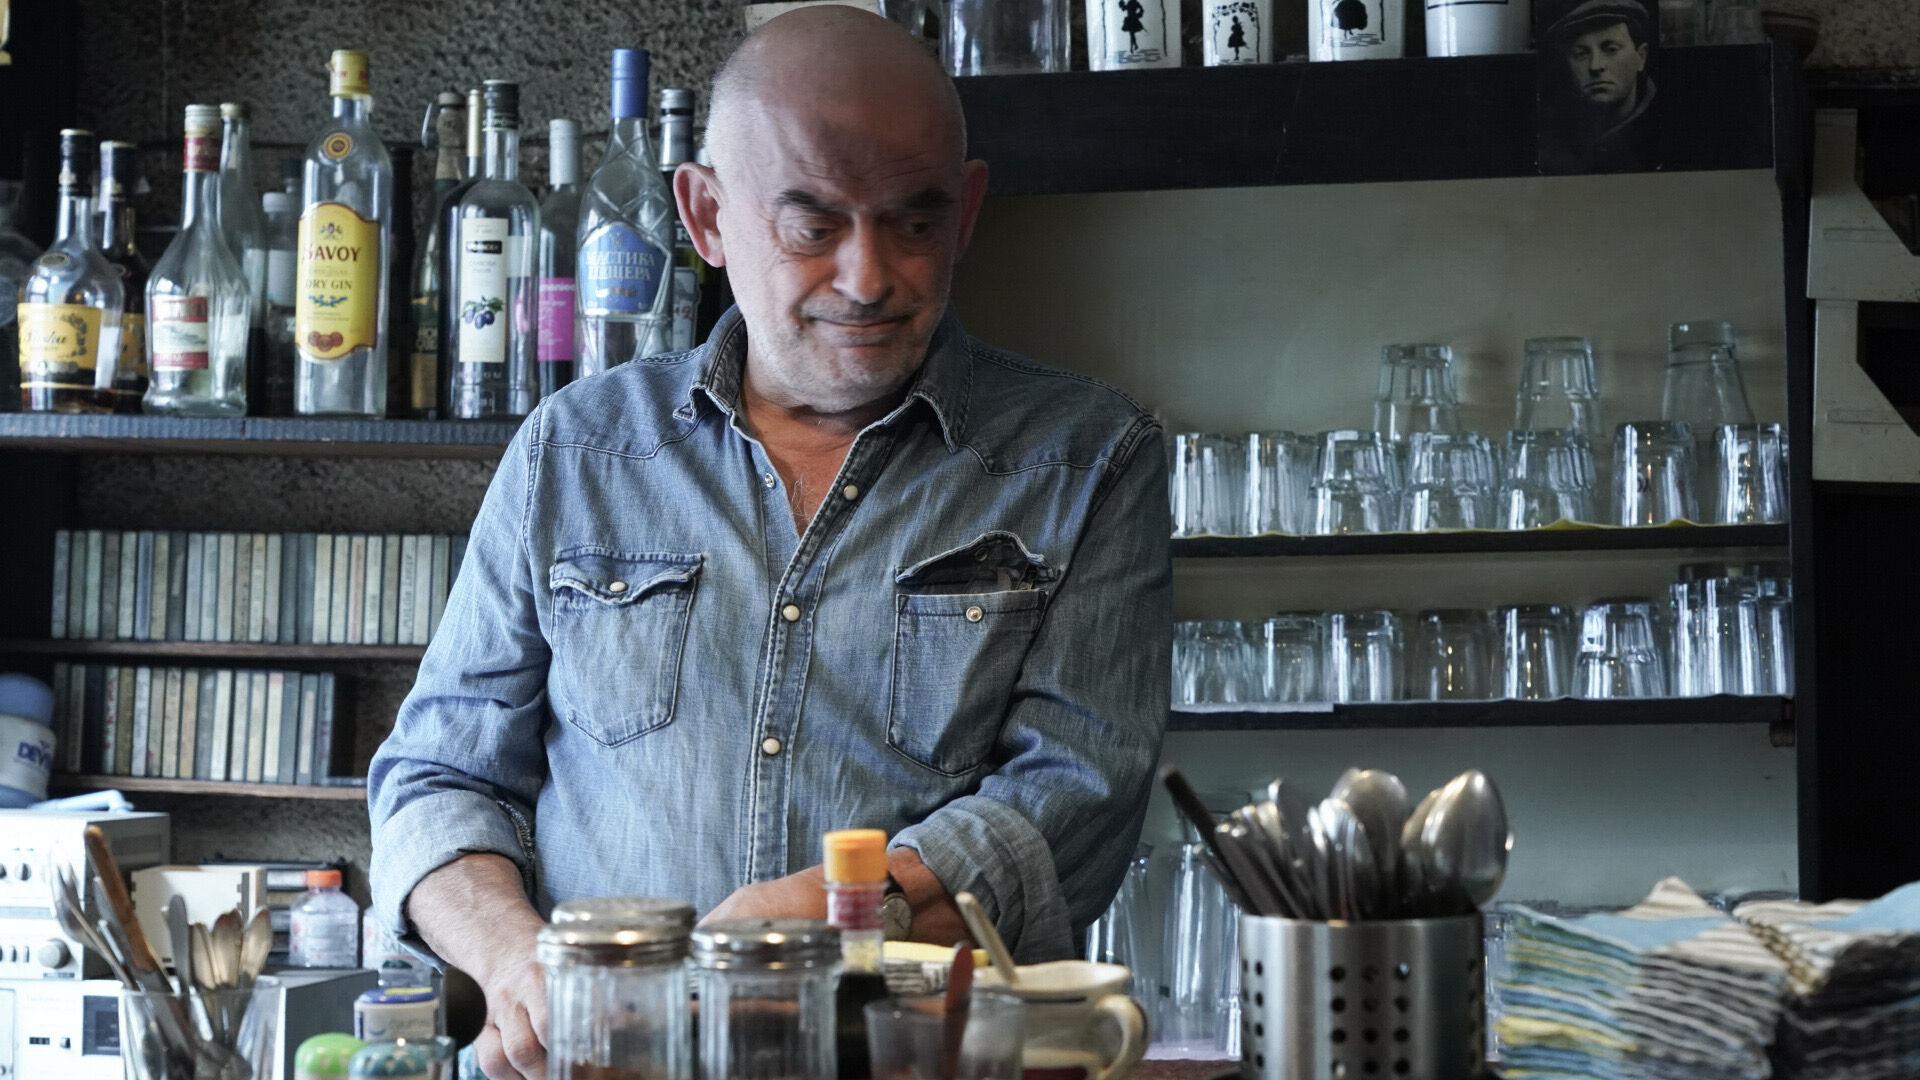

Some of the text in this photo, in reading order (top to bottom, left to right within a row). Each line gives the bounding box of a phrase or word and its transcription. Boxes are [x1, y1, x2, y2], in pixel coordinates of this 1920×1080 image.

[302, 243, 361, 263] SAVOY
[586, 251, 655, 266] МАСТИКА
[588, 265, 651, 282] ПЕЩЕРА
[305, 279, 352, 290] DRY GIN
